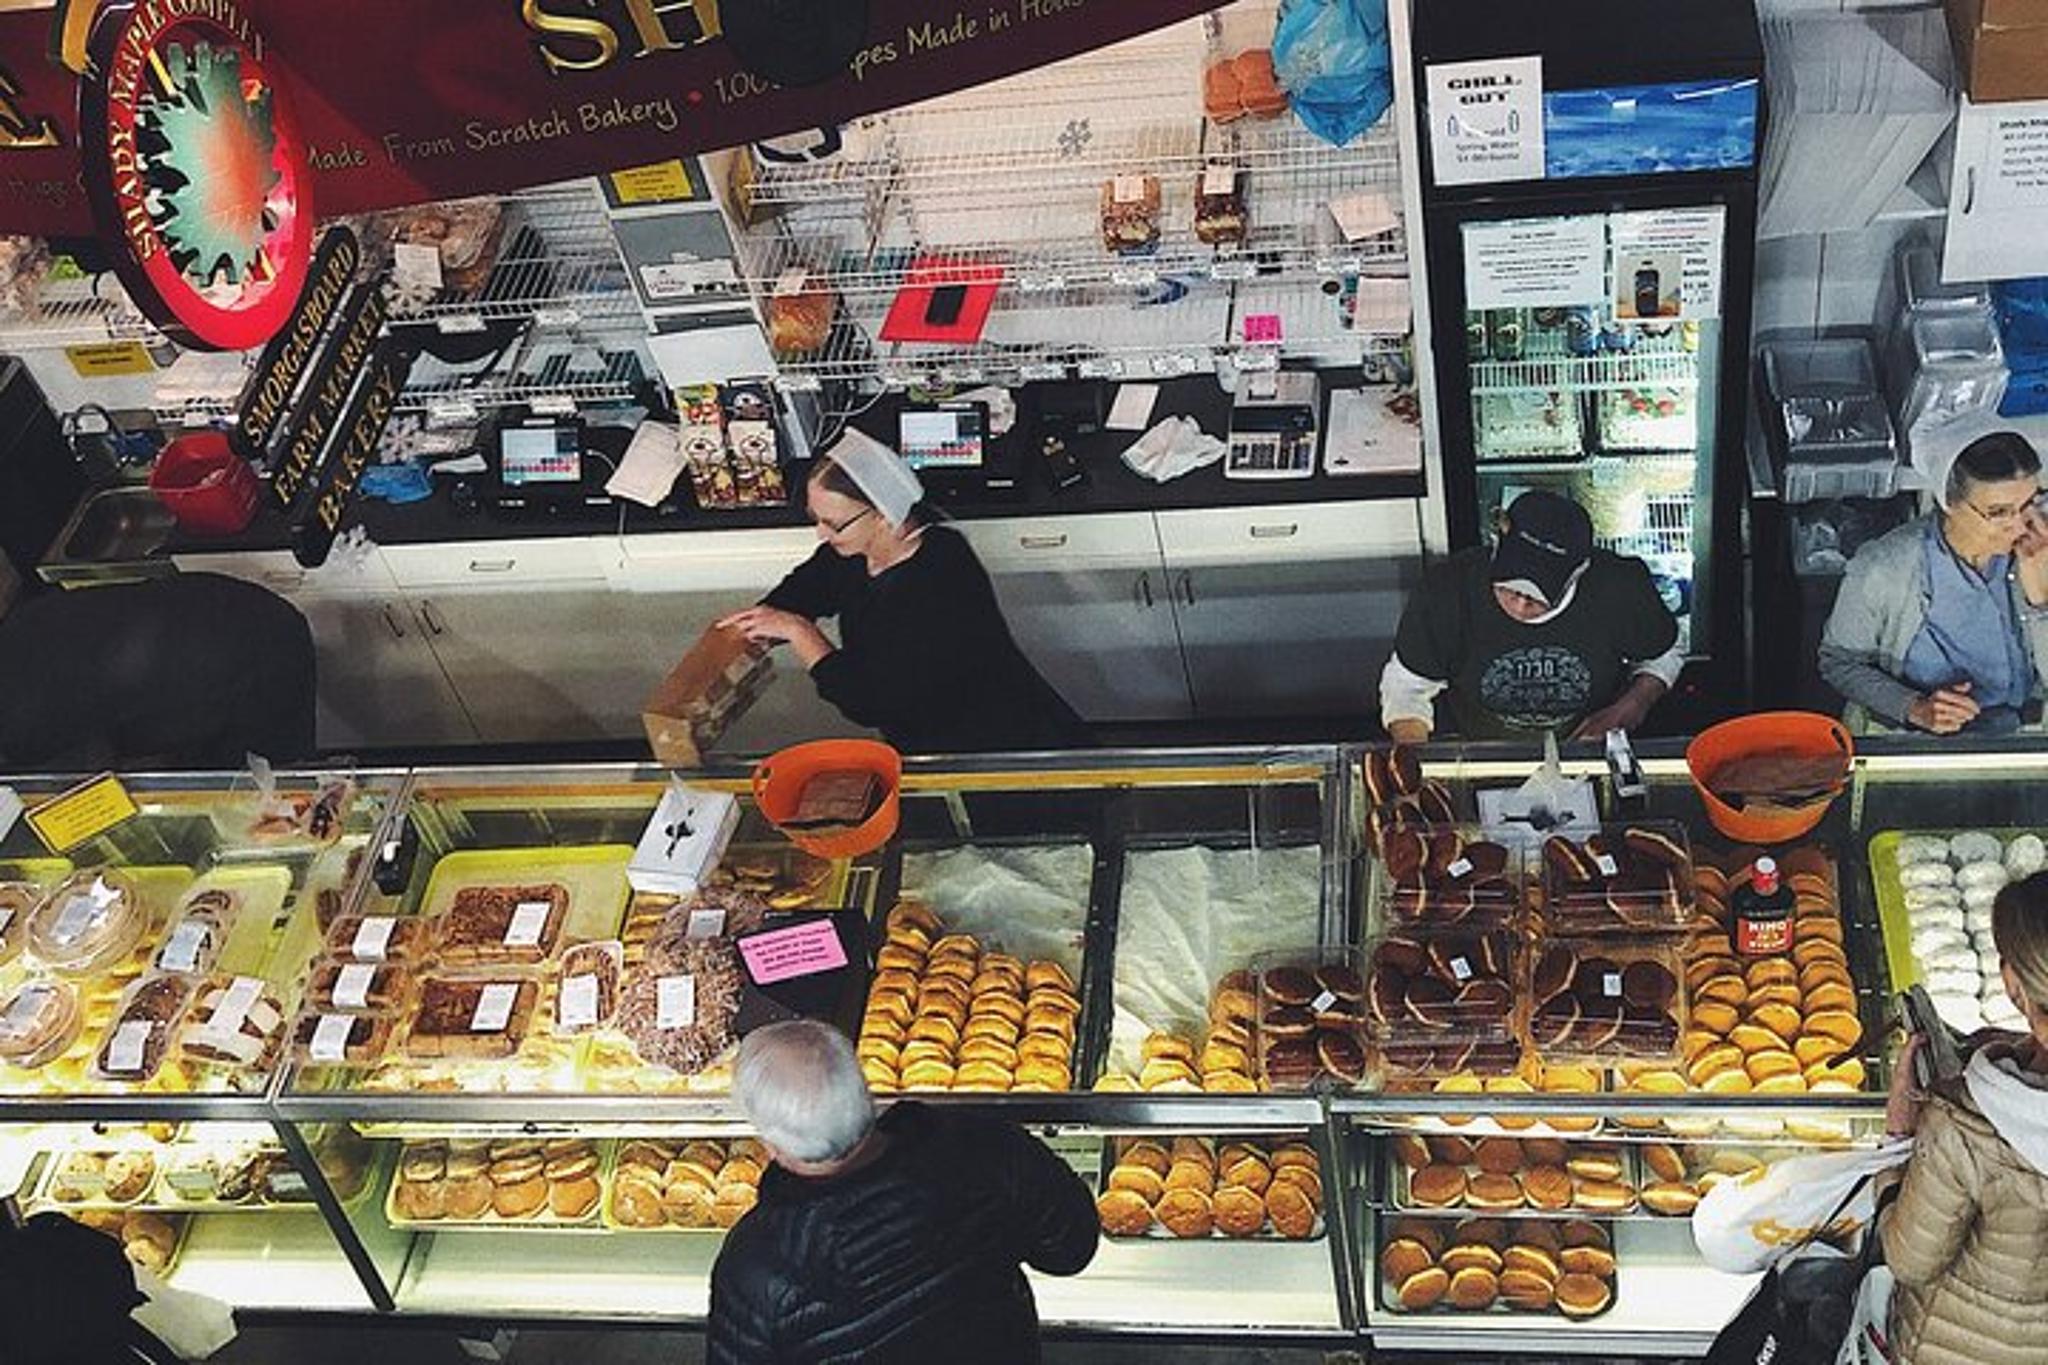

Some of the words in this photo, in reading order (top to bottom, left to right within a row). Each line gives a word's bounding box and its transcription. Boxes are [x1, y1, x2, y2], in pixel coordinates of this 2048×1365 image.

[109, 2, 166, 109] MAPLE
[383, 133, 456, 163] From
[465, 112, 571, 152] Scratch
[577, 98, 679, 131] Bakery
[714, 71, 782, 104] 1,00
[849, 46, 898, 81] pes
[907, 12, 979, 55] Made
[989, 8, 1011, 31] in
[1020, 0, 1083, 21] Hous
[1460, 90, 1511, 104] OUT
[110, 121, 158, 259] SHADY
[245, 241, 353, 448] SMORGASBOARD
[273, 413, 323, 505] FARM
[320, 290, 382, 410] MARKET
[317, 364, 396, 532] BAKERY
